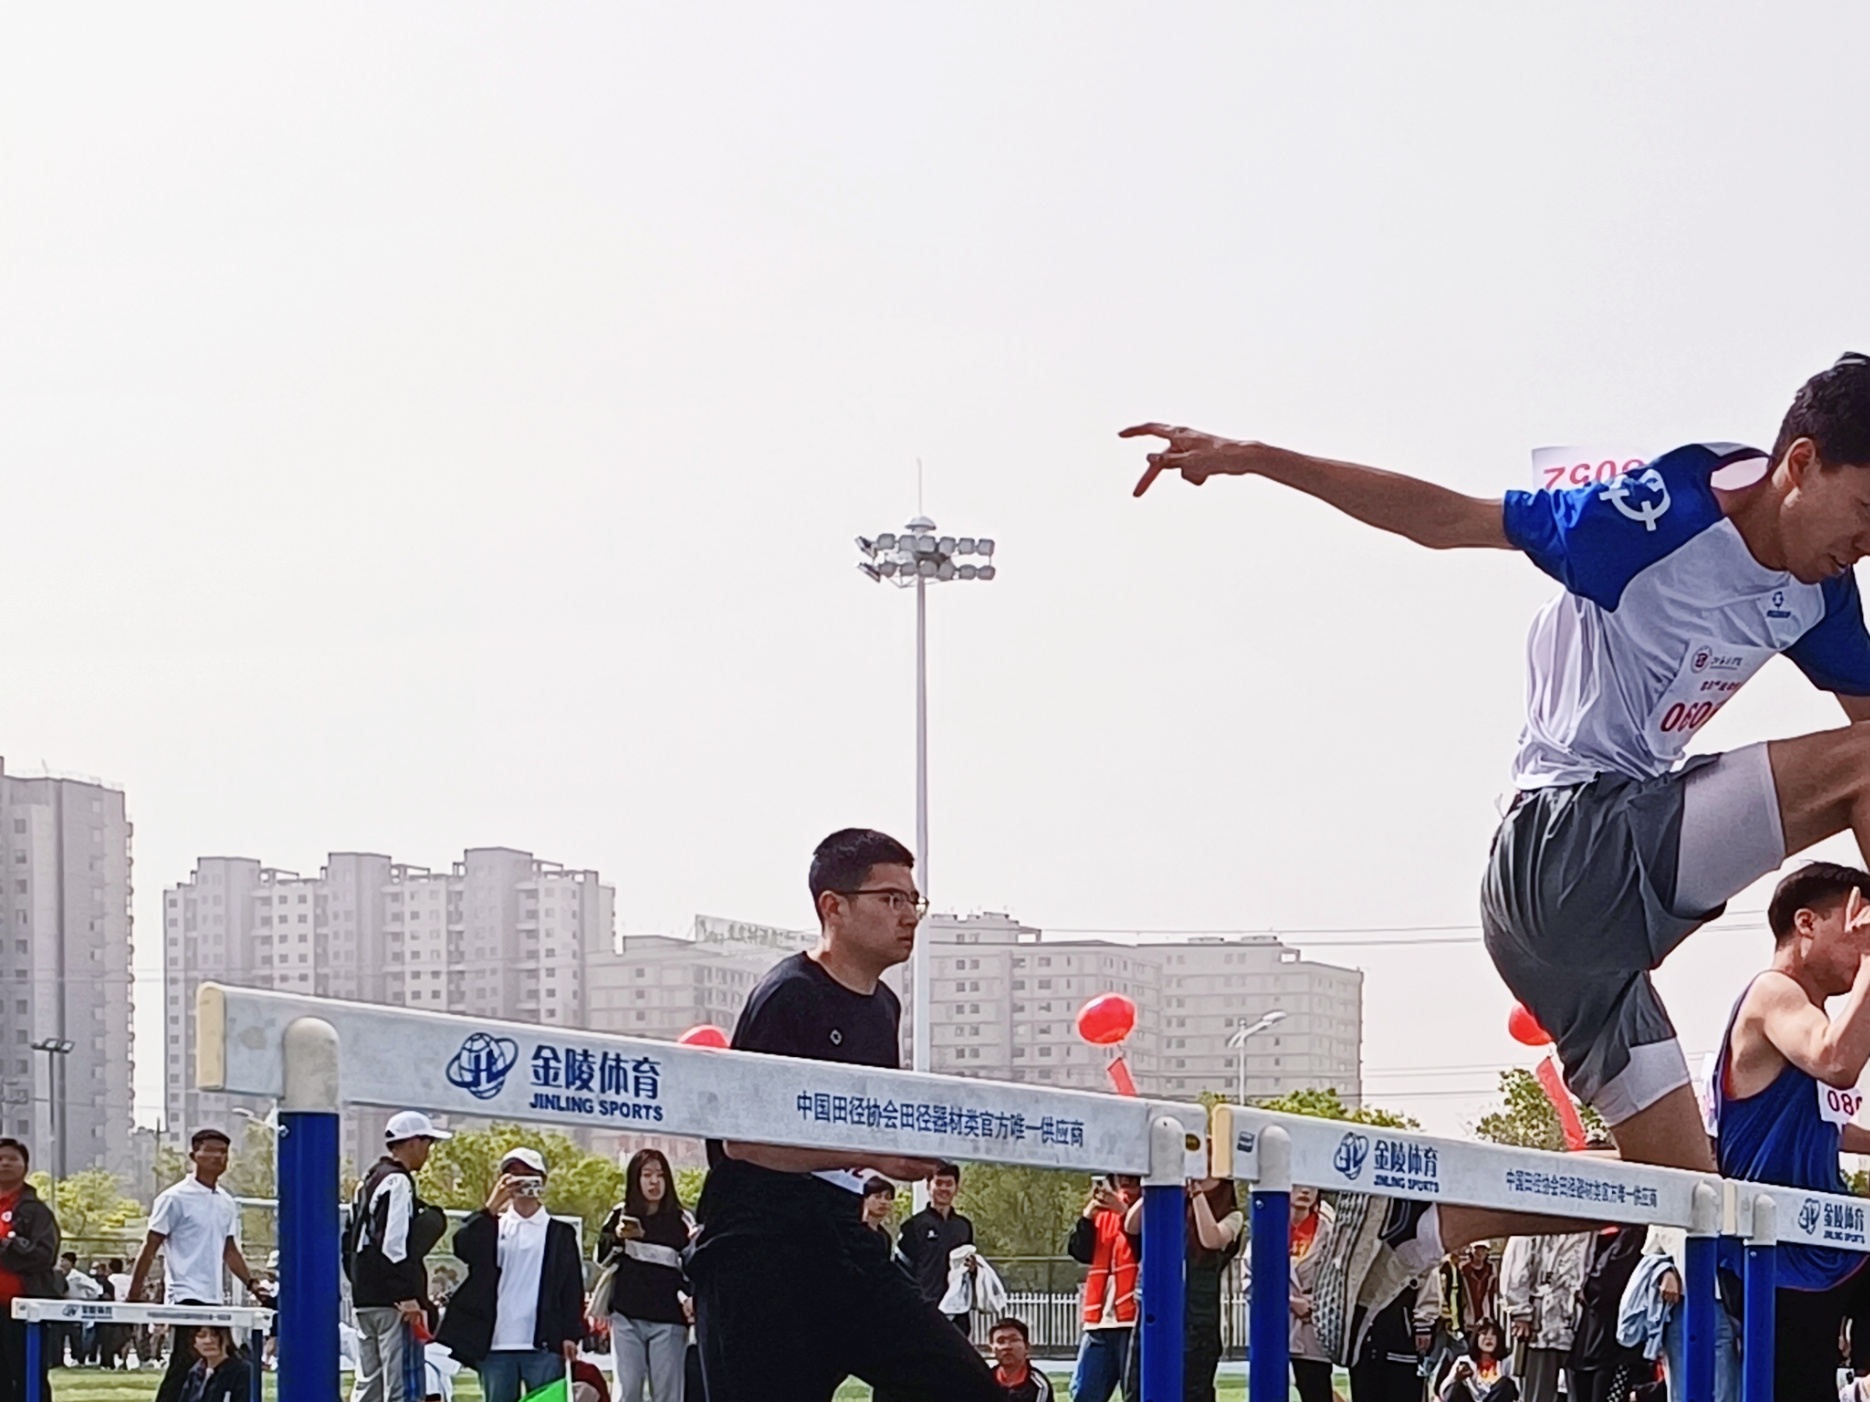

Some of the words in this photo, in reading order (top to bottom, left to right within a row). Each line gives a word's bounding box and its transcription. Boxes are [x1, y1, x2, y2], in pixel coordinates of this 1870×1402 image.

[529, 1044, 662, 1100] 金陵体育
[529, 1092, 594, 1114] JINLING
[598, 1099, 664, 1122] SPORTS
[796, 1089, 1085, 1149] 中国田径协会田径器材类官方唯一供应商
[1373, 1139, 1439, 1178] 金陵体育
